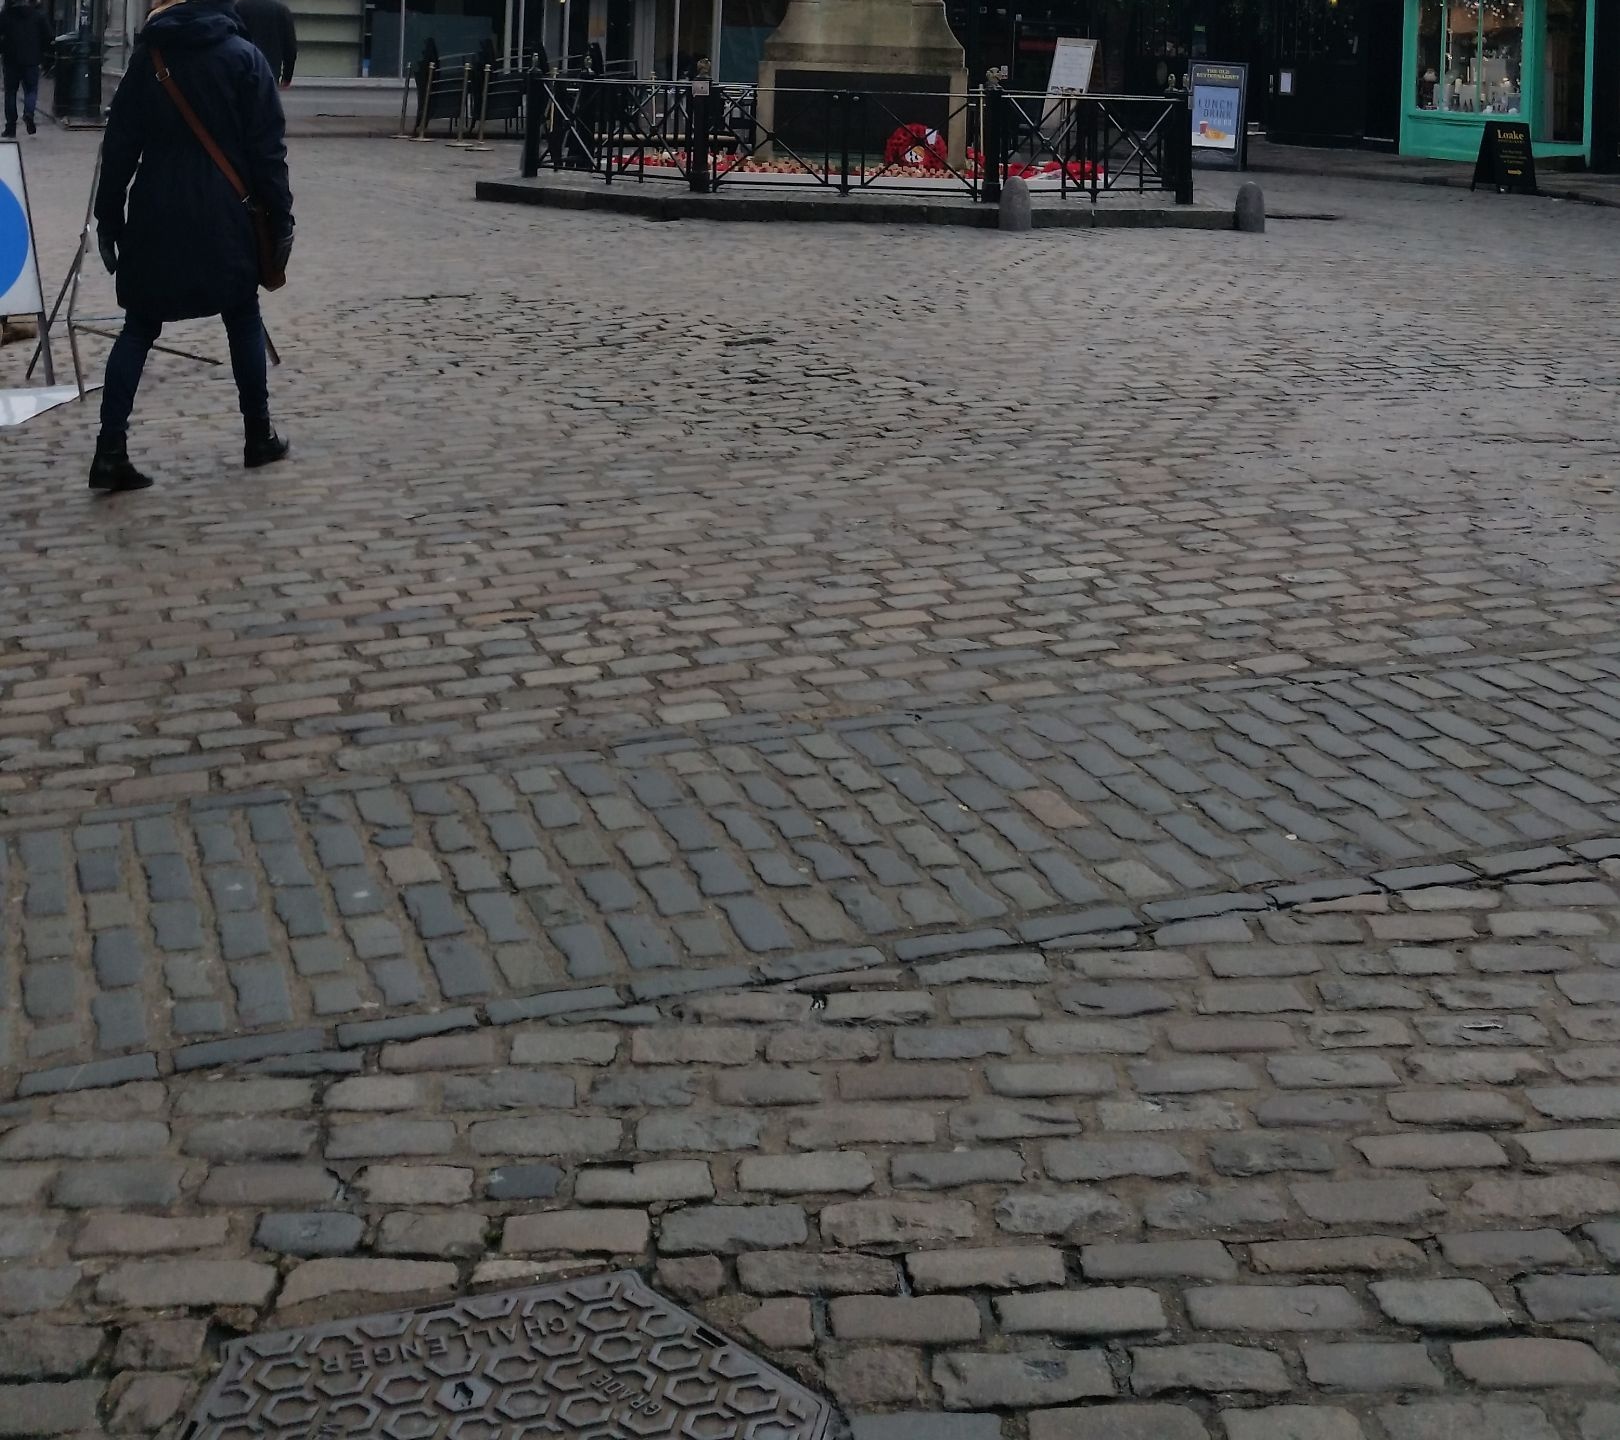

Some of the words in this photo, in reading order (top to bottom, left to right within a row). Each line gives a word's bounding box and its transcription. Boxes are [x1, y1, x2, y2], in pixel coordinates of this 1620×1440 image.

[1198, 98, 1233, 110] LUNCH
[1203, 108, 1232, 120] DRINK
[320, 1315, 568, 1373] CHALLENGER
[591, 1374, 662, 1415] GRADE
